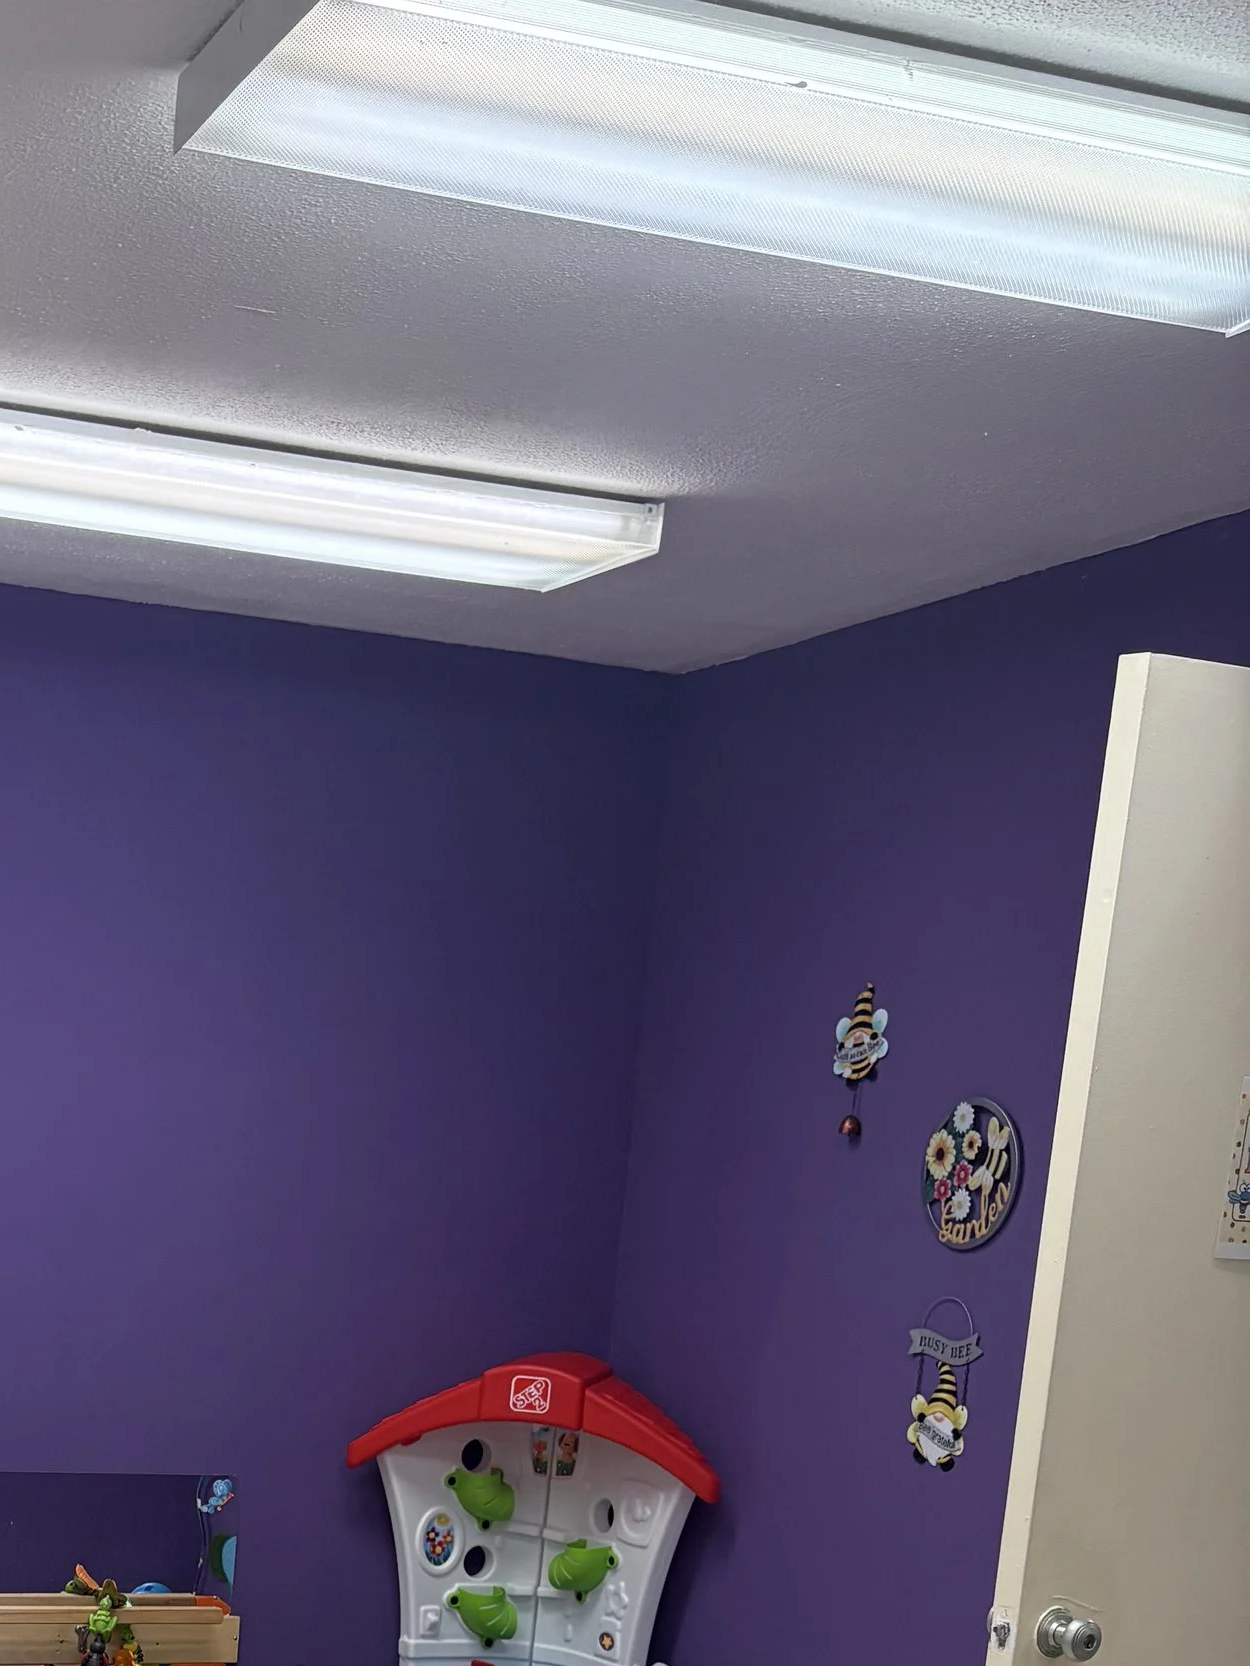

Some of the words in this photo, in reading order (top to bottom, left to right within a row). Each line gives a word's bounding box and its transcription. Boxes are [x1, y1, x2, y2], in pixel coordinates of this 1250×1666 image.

[939, 1182, 1011, 1244] Garden
[919, 1335, 949, 1355] BUSY
[951, 1343, 972, 1359] BEE
[513, 1380, 545, 1409] STEP
